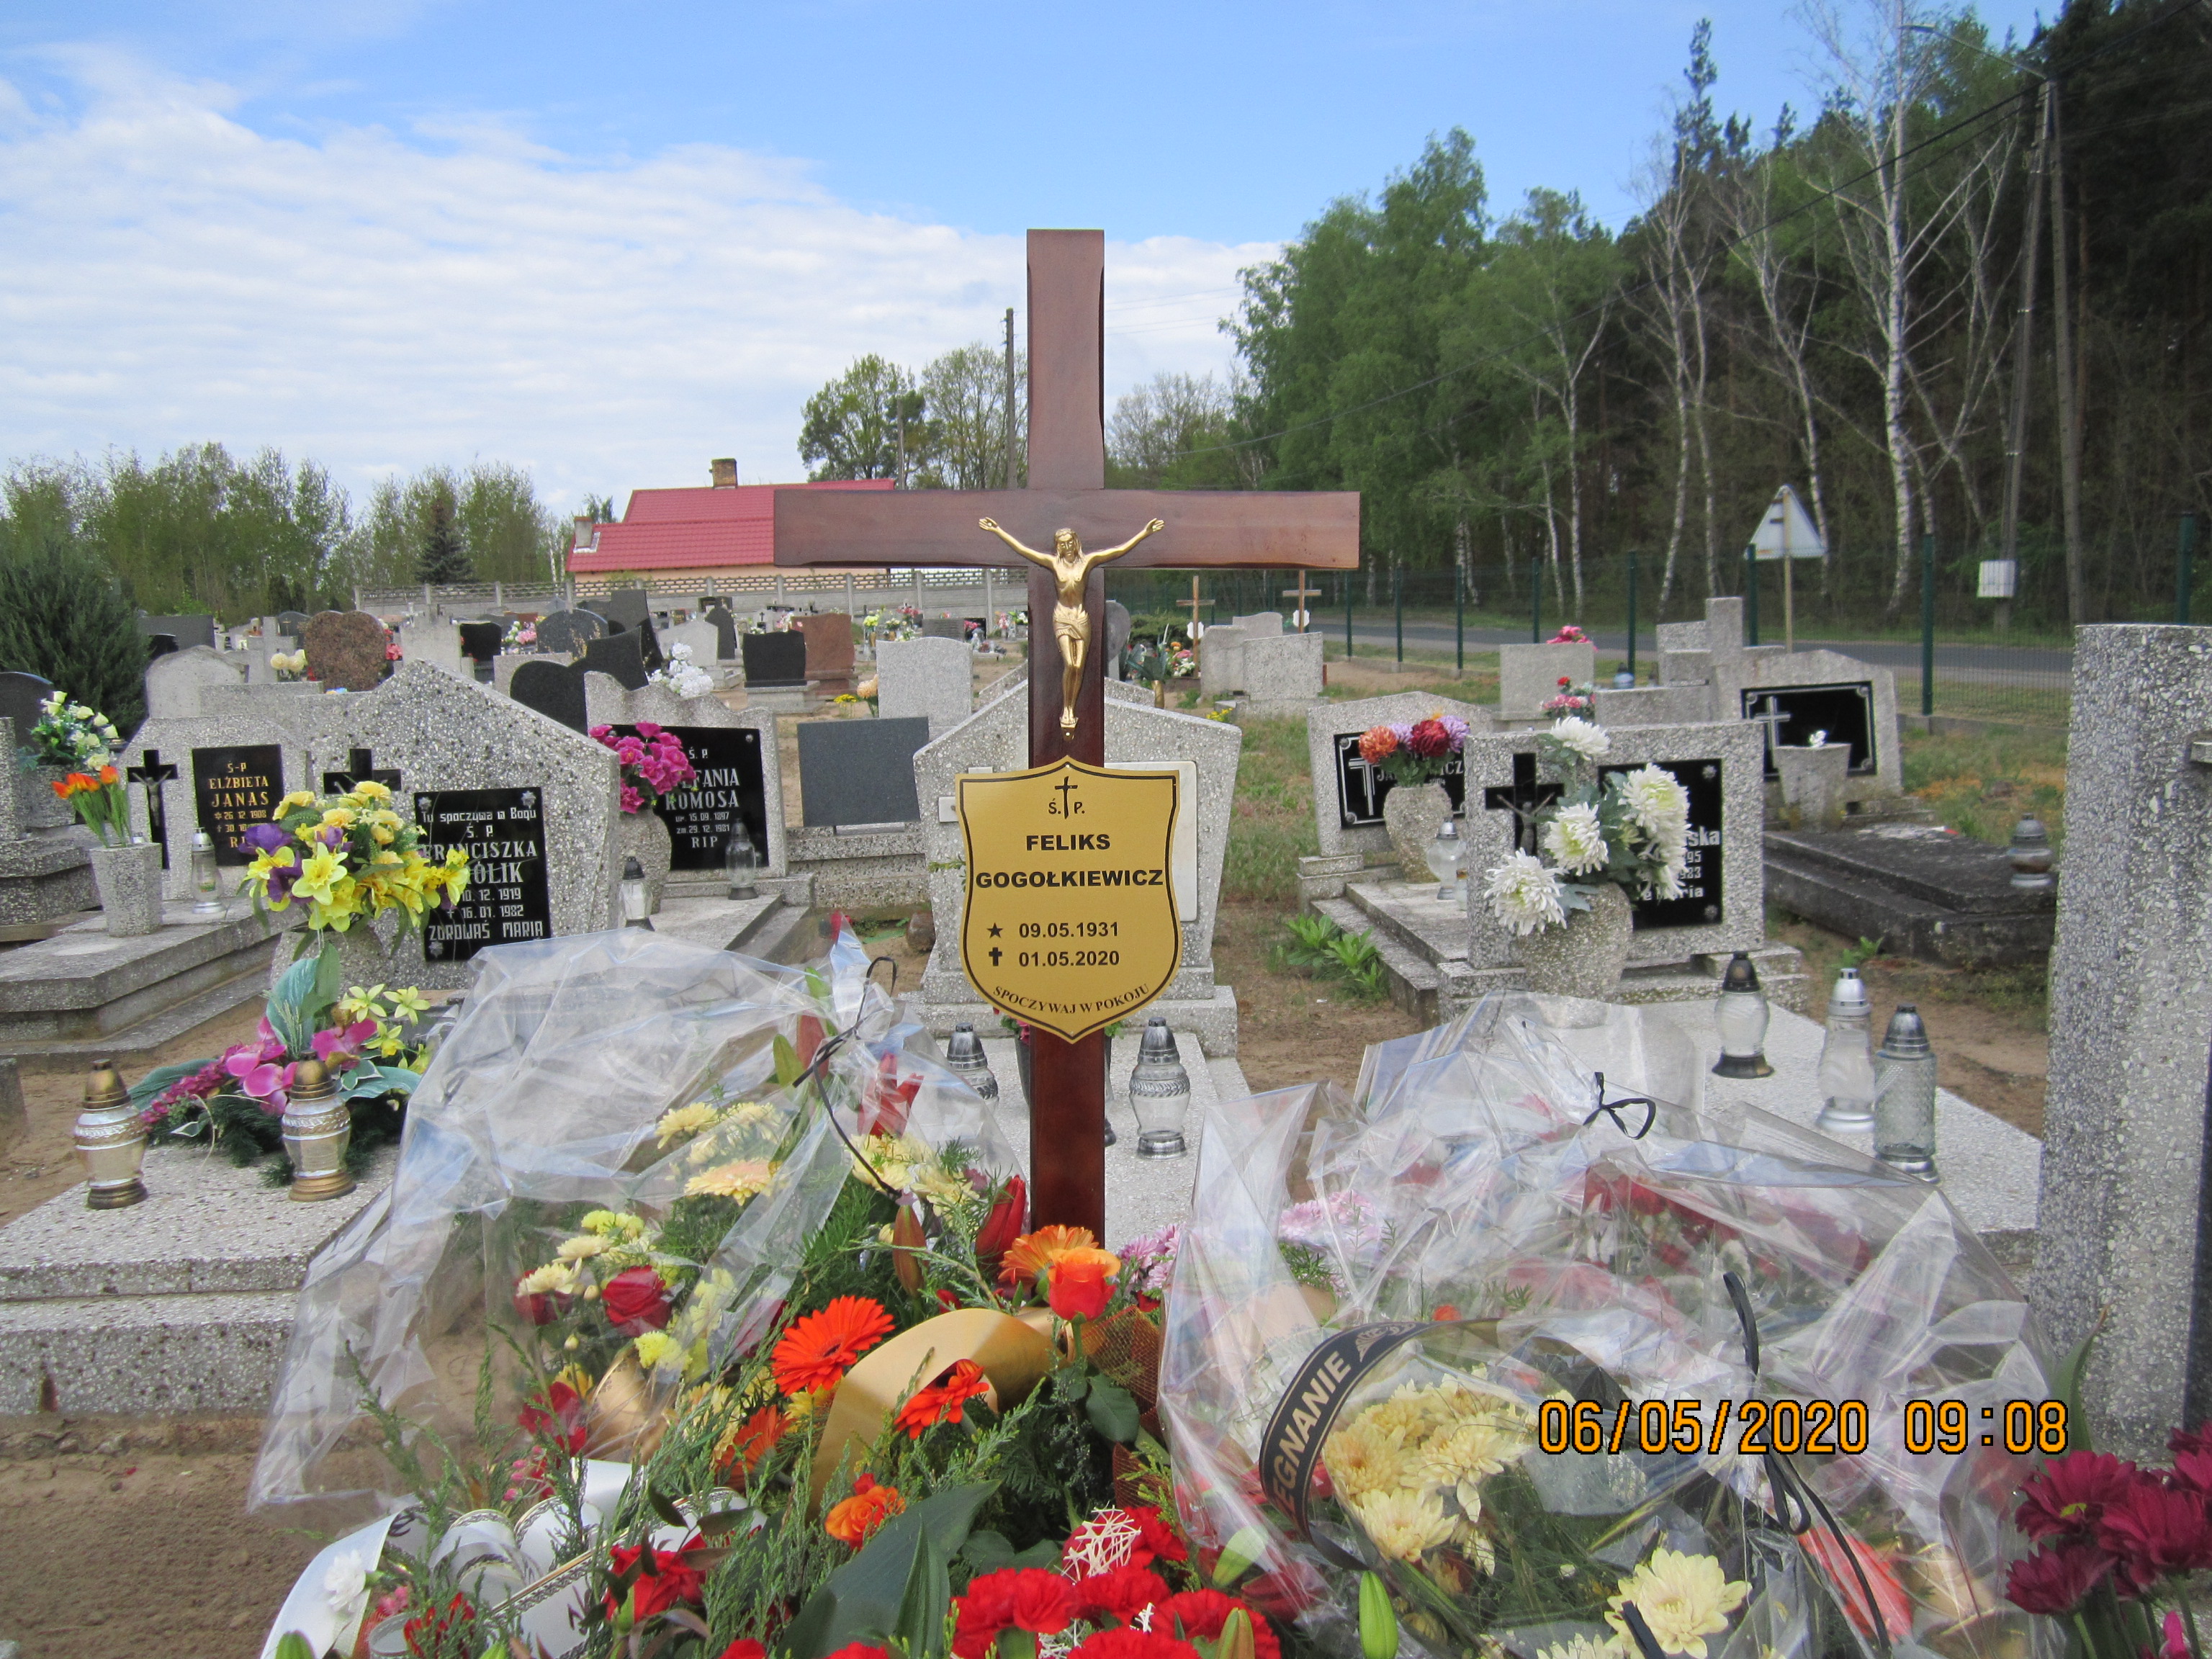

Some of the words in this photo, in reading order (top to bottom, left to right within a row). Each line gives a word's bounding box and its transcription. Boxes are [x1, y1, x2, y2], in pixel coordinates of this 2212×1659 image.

[209, 775, 269, 789] ELŻBIETA
[682, 768, 739, 788] FANIA
[211, 791, 269, 807] JANAS
[665, 790, 739, 811] KOMOSA
[1048, 798, 1061, 814] Ś.
[1074, 801, 1085, 814] P.
[422, 811, 433, 823] Tu
[439, 811, 493, 824] spoczywa
[497, 810, 505, 820] w
[511, 807, 536, 821] Bogu
[714, 812, 730, 821] 1897
[1026, 834, 1111, 851] FELIKS
[467, 860, 524, 885] ÓLIK
[976, 869, 1164, 889] GOGOŁKIEWICZ
[500, 887, 521, 900] 1919
[501, 904, 524, 917] 1982
[428, 919, 490, 941] ZDROWAŚ
[503, 921, 543, 938] MARIA
[1019, 922, 1118, 938] 09.05.1931
[1019, 950, 1120, 967] 01.05.2020
[993, 986, 1076, 1014] SPOCZYWAJ
[1079, 1003, 1092, 1013] W
[1096, 984, 1150, 1011] POKOJU
